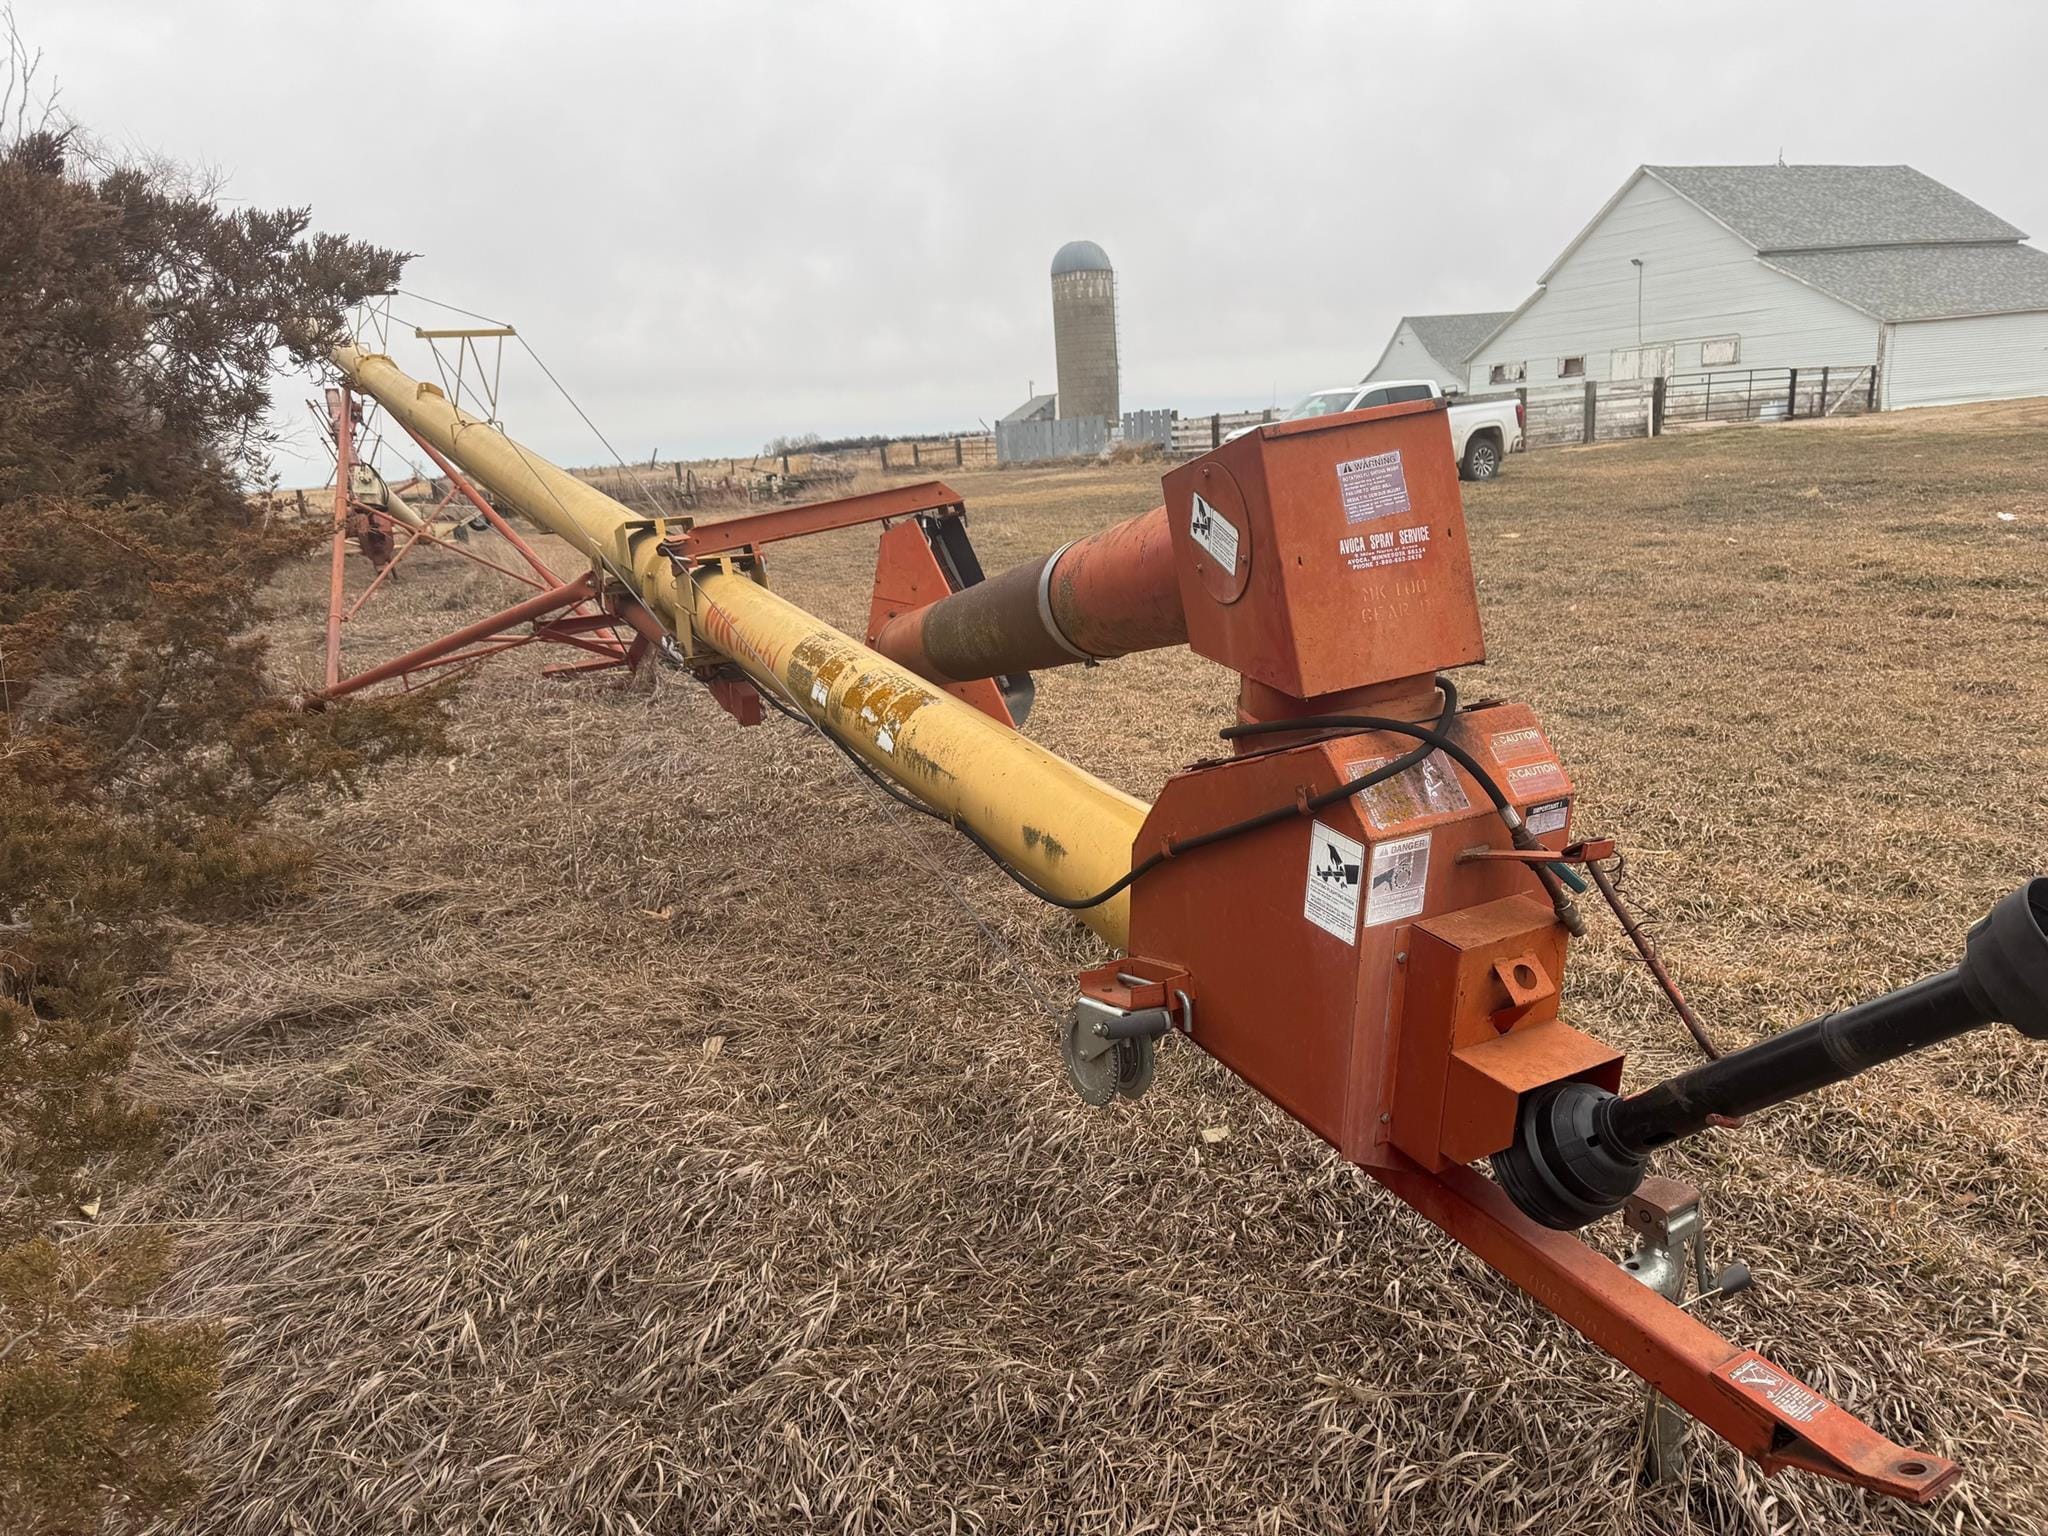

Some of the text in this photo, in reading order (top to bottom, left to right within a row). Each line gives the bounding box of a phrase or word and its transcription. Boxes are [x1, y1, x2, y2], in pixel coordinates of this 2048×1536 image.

[1354, 456, 1396, 471] WARNING
[1340, 526, 1430, 555] AVOCA SPRAY SERVICE
[1371, 551, 1406, 561] MINNESOTA
[1352, 561, 1374, 570] PHONE
[1500, 729, 1539, 745] CAUTION
[1517, 762, 1557, 778] CAUTION
[1391, 839, 1426, 854] DANGER
